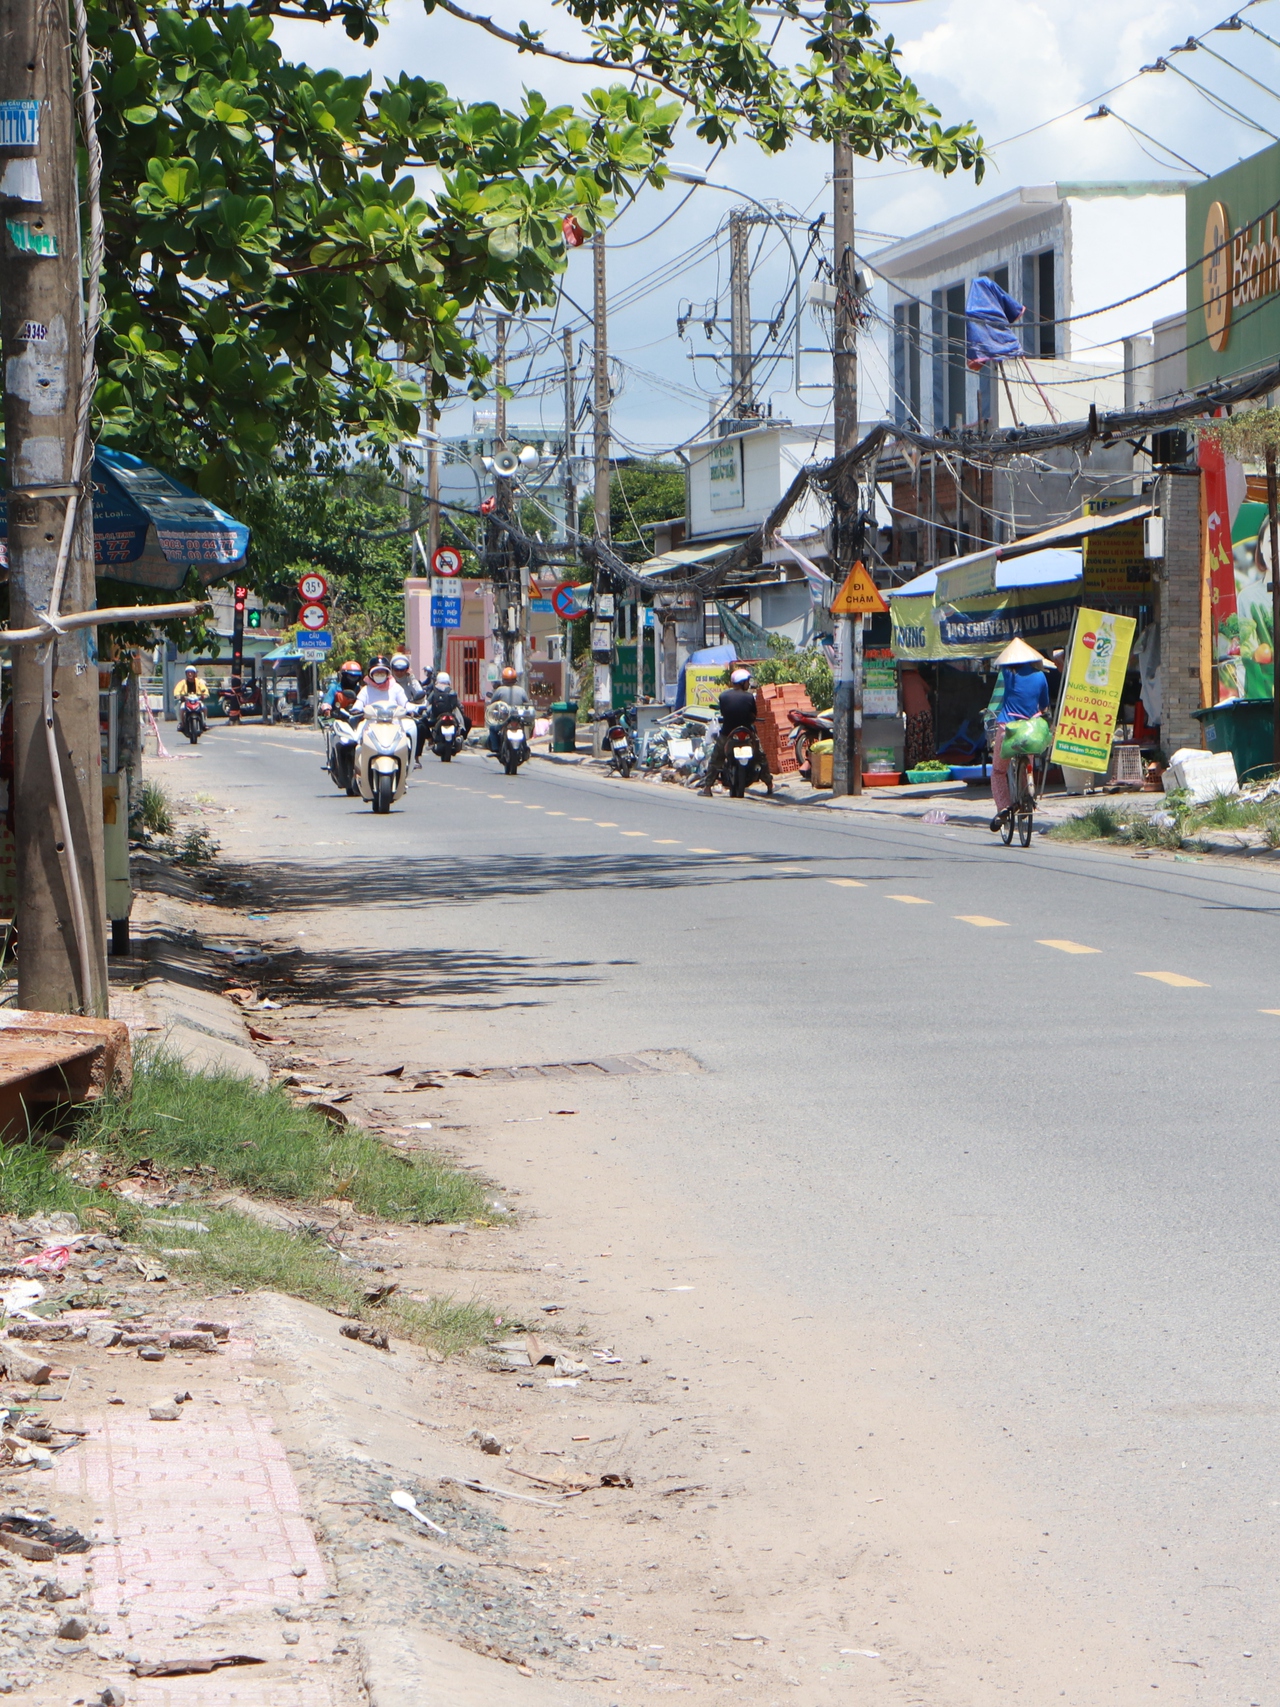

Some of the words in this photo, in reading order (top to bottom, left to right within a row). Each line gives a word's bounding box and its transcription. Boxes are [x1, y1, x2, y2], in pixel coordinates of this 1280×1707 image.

[1233, 216, 1270, 308] Bách
[107, 539, 130, 550] 77
[202, 538, 217, 549] 44
[107, 550, 131, 561] 77
[203, 550, 219, 561] 44
[853, 583, 864, 591] ĐI
[845, 594, 874, 605] CHẬM
[1068, 681, 1088, 692] Nước
[1090, 685, 1106, 695] Sâm
[1109, 689, 1119, 699] C2
[1063, 705, 1099, 724] MUA
[1103, 714, 1113, 726] 2
[1059, 721, 1100, 742] TẶNG
[1105, 732, 1111, 744] 1
